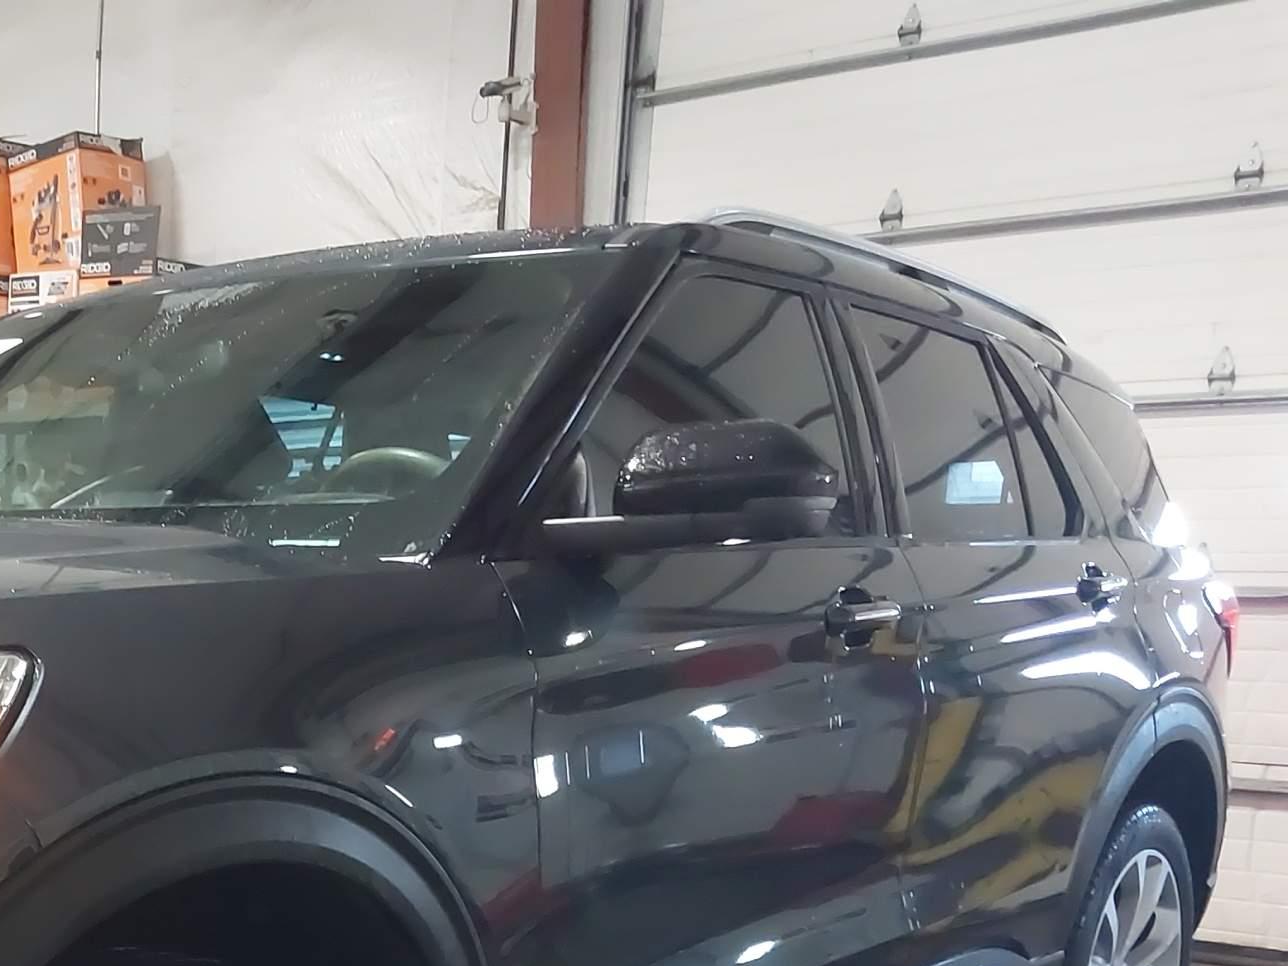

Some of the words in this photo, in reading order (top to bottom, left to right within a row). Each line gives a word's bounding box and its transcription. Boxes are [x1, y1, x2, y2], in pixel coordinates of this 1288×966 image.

[8, 149, 37, 168] RIDGID
[80, 262, 111, 274] RIDGID
[12, 280, 38, 291] RIDGID
